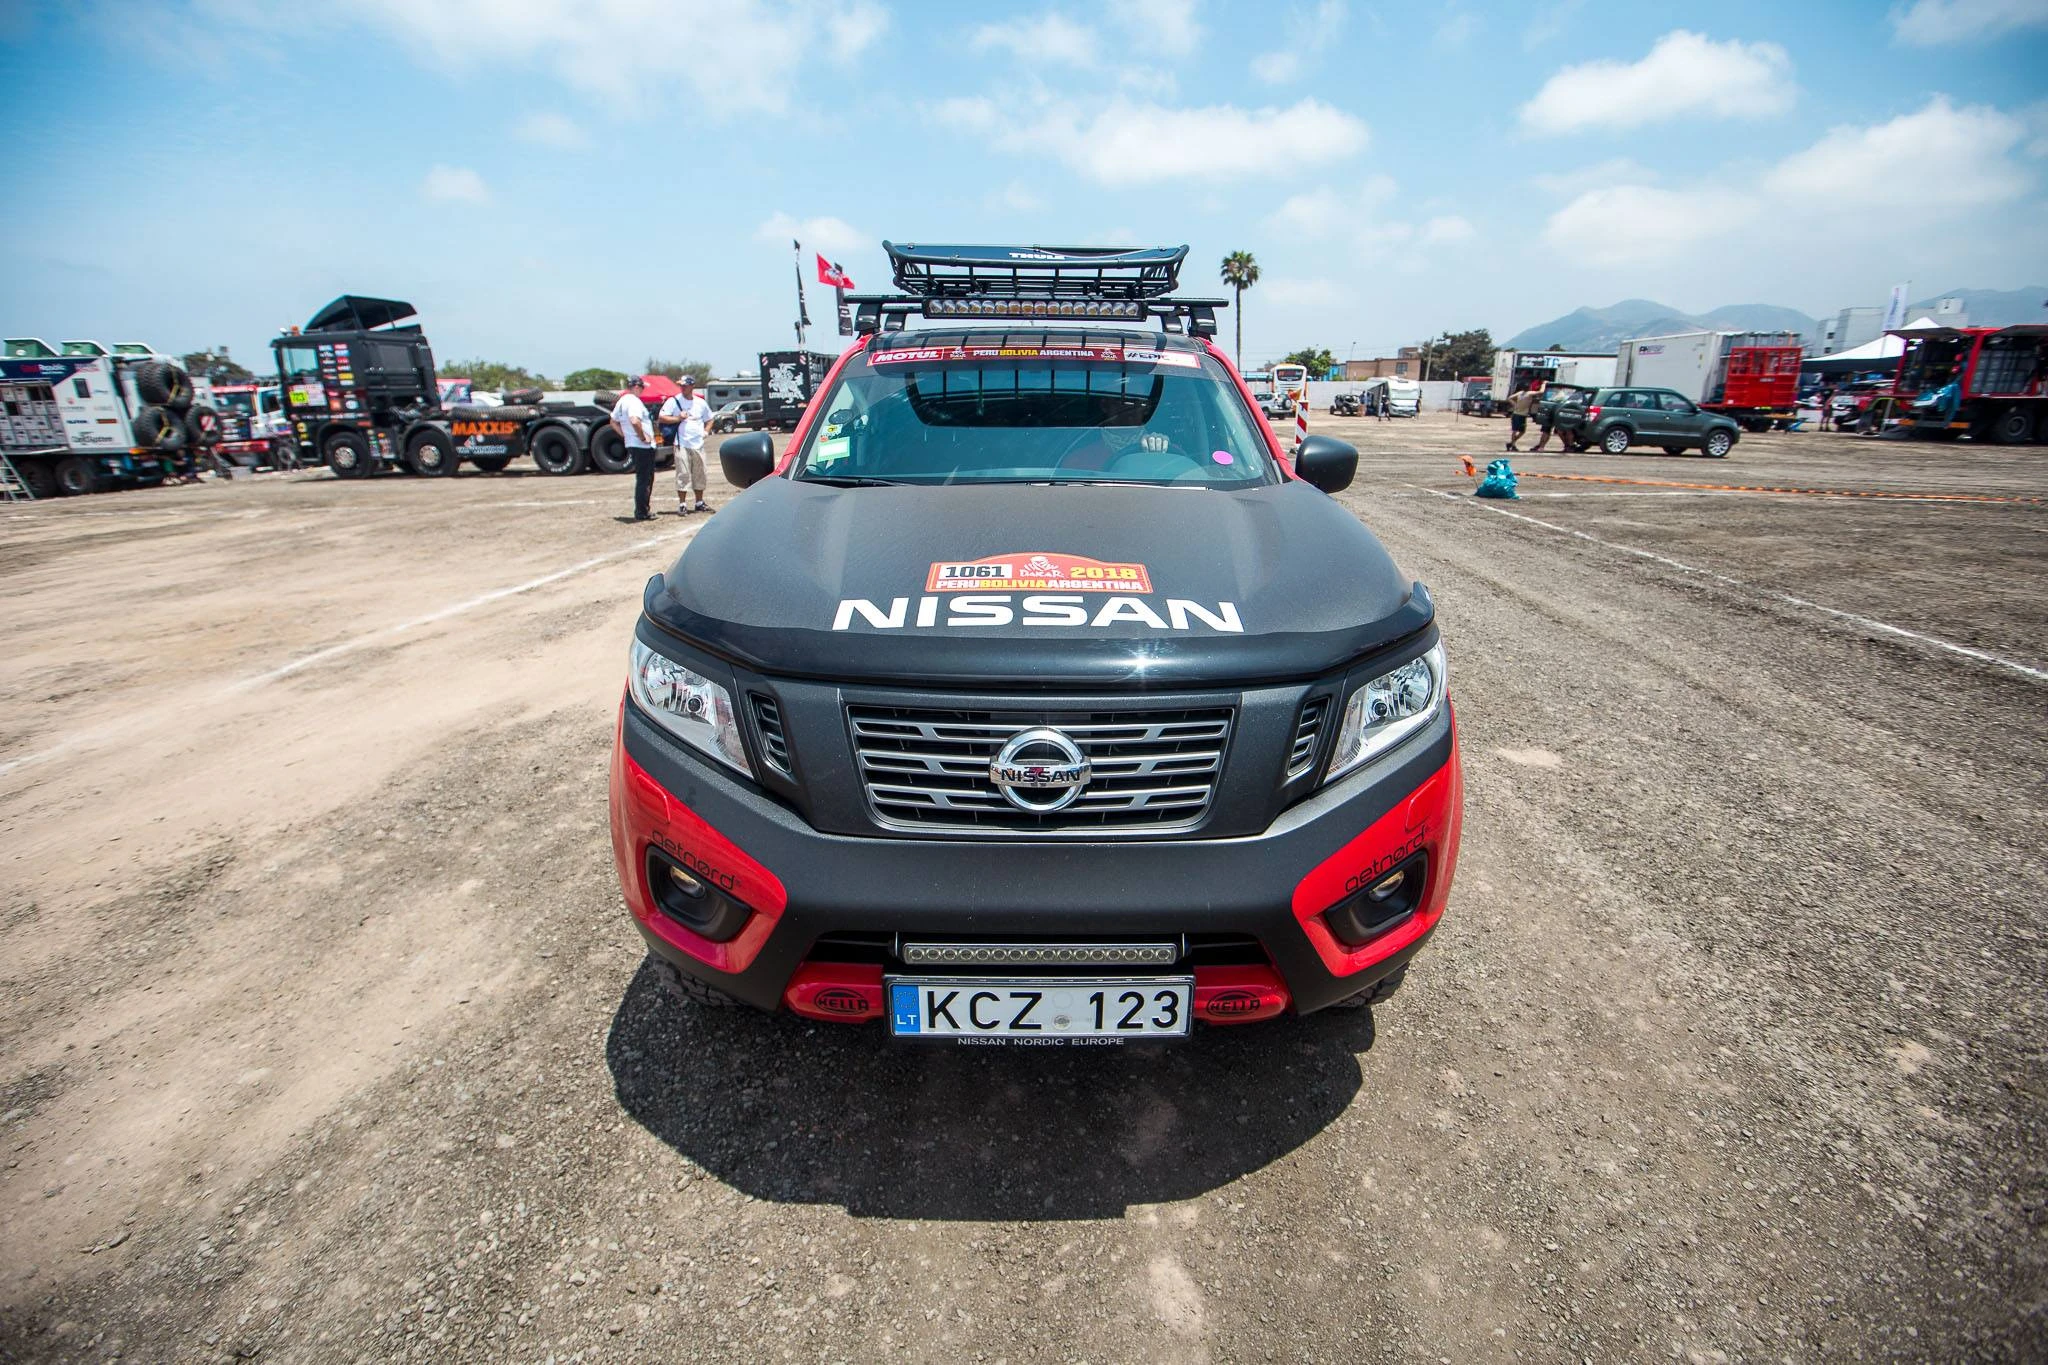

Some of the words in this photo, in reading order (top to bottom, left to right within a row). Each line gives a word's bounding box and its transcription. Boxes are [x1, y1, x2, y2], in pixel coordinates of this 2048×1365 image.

[874, 350, 940, 362] MOTUL
[1039, 349, 1095, 357] ARGENTINA
[451, 420, 516, 436] MAXXIS
[945, 565, 1005, 578] 1061
[1019, 567, 1065, 578] DAKAR
[1070, 566, 1138, 580] 2018
[832, 595, 1244, 633] NISSAN
[1001, 766, 1080, 783] NISSAN
[818, 996, 870, 1012] HELLA
[926, 990, 1043, 1030] KCZ
[1088, 989, 1180, 1030] 123
[1209, 997, 1261, 1012] HELLA
[896, 1014, 917, 1026] LT
[957, 1037, 1007, 1046] NISSAN
[1013, 1037, 1065, 1046] NORDIC
[1071, 1037, 1125, 1046] EUROPE
